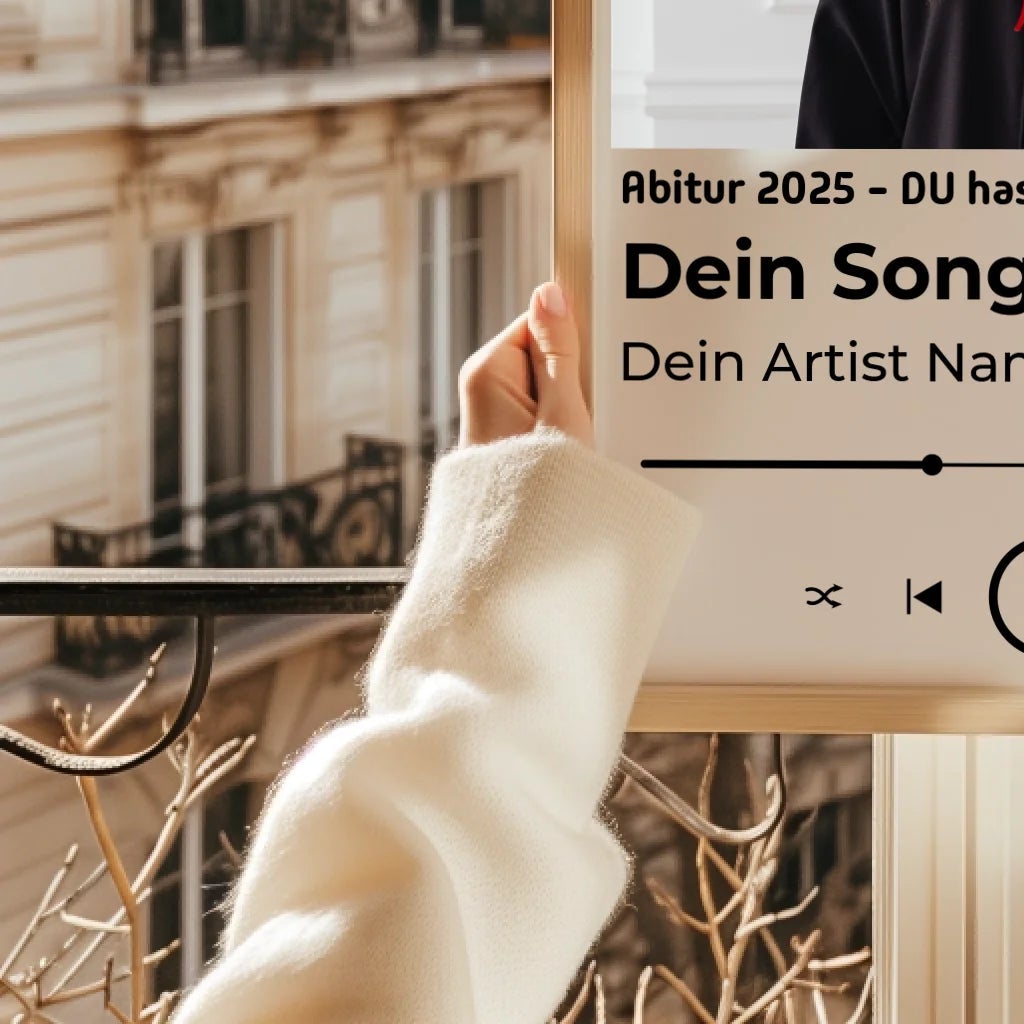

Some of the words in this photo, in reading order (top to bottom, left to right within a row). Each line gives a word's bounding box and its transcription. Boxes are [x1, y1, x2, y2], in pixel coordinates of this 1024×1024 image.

[622, 168, 747, 205] Abitur
[757, 170, 855, 205] 2025
[868, 187, 888, 195] -
[902, 170, 955, 205] DU
[625, 236, 806, 300] Dein
[623, 339, 743, 382] Dein
[761, 339, 909, 382] Artist
